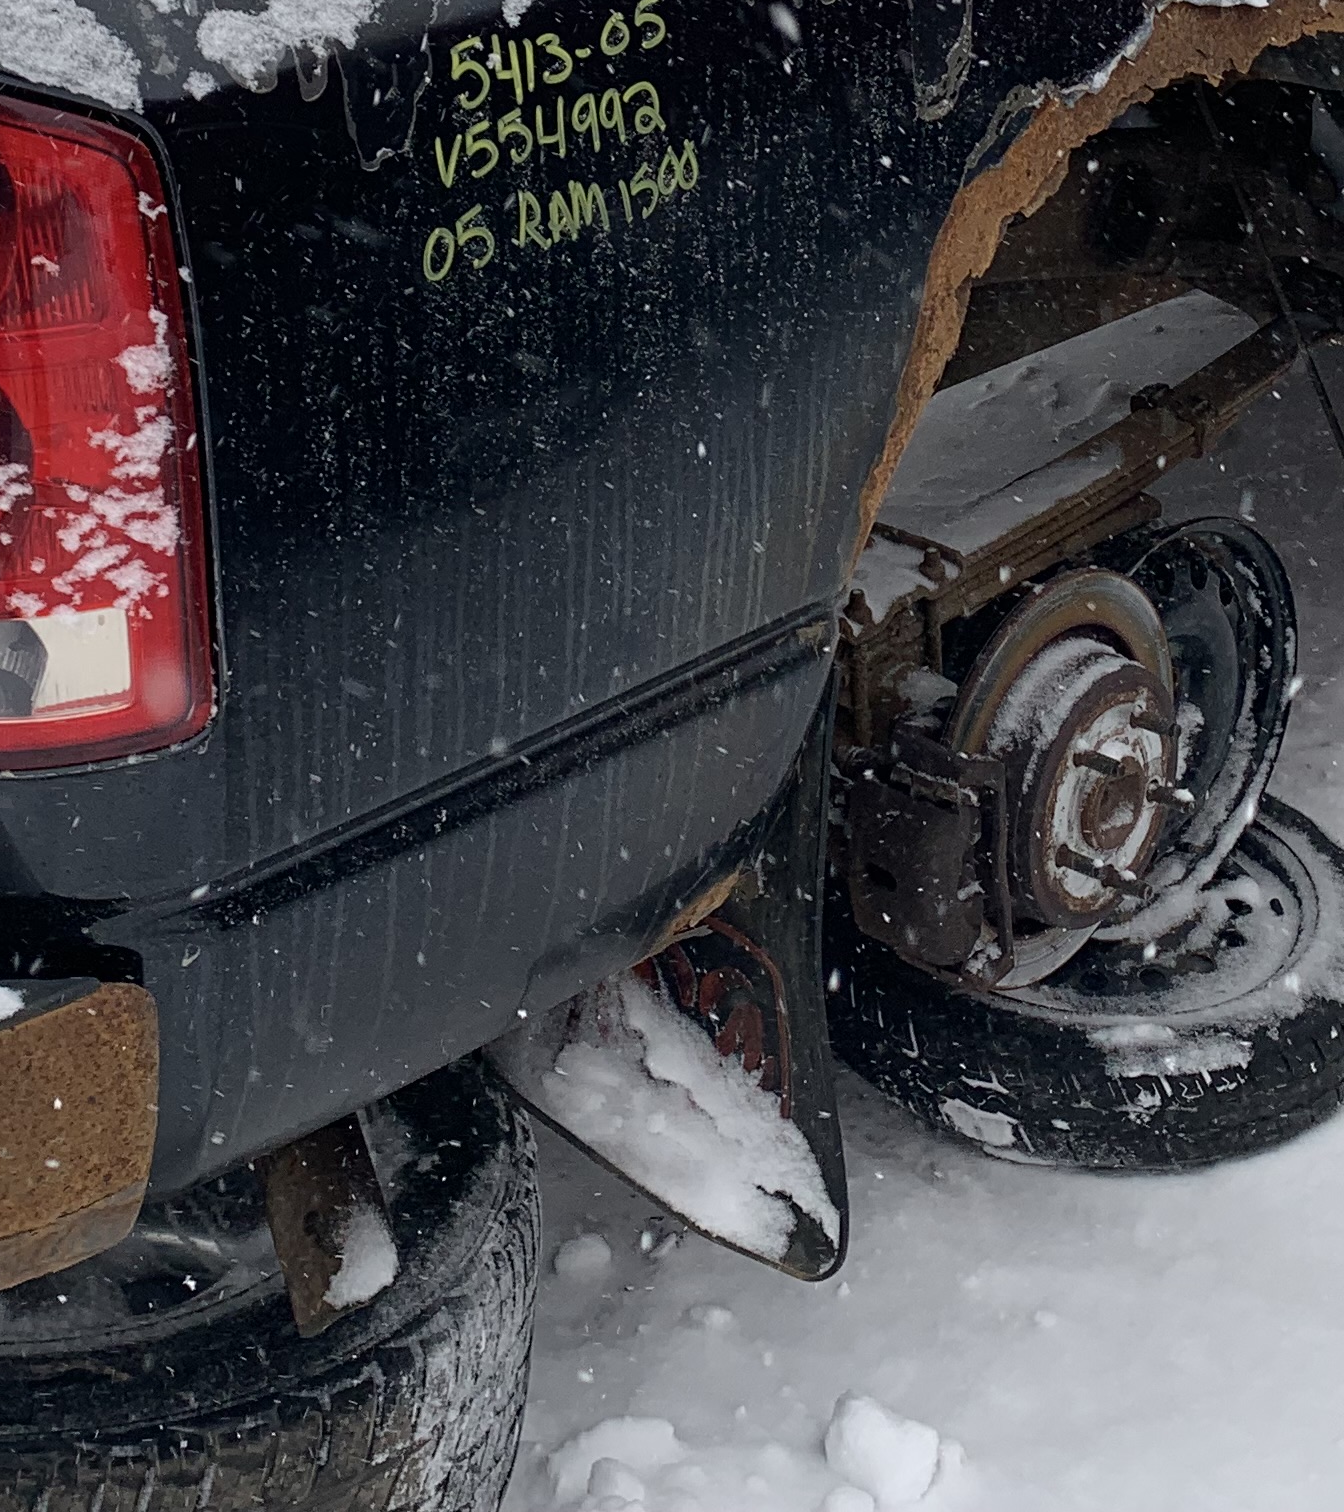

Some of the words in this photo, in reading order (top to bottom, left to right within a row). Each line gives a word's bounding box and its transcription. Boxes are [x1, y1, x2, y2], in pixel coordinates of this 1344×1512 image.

[435, 81, 666, 188] V554992
[423, 204, 495, 282] 05
[513, 180, 610, 250] RAM
[618, 139, 699, 223] 1500
